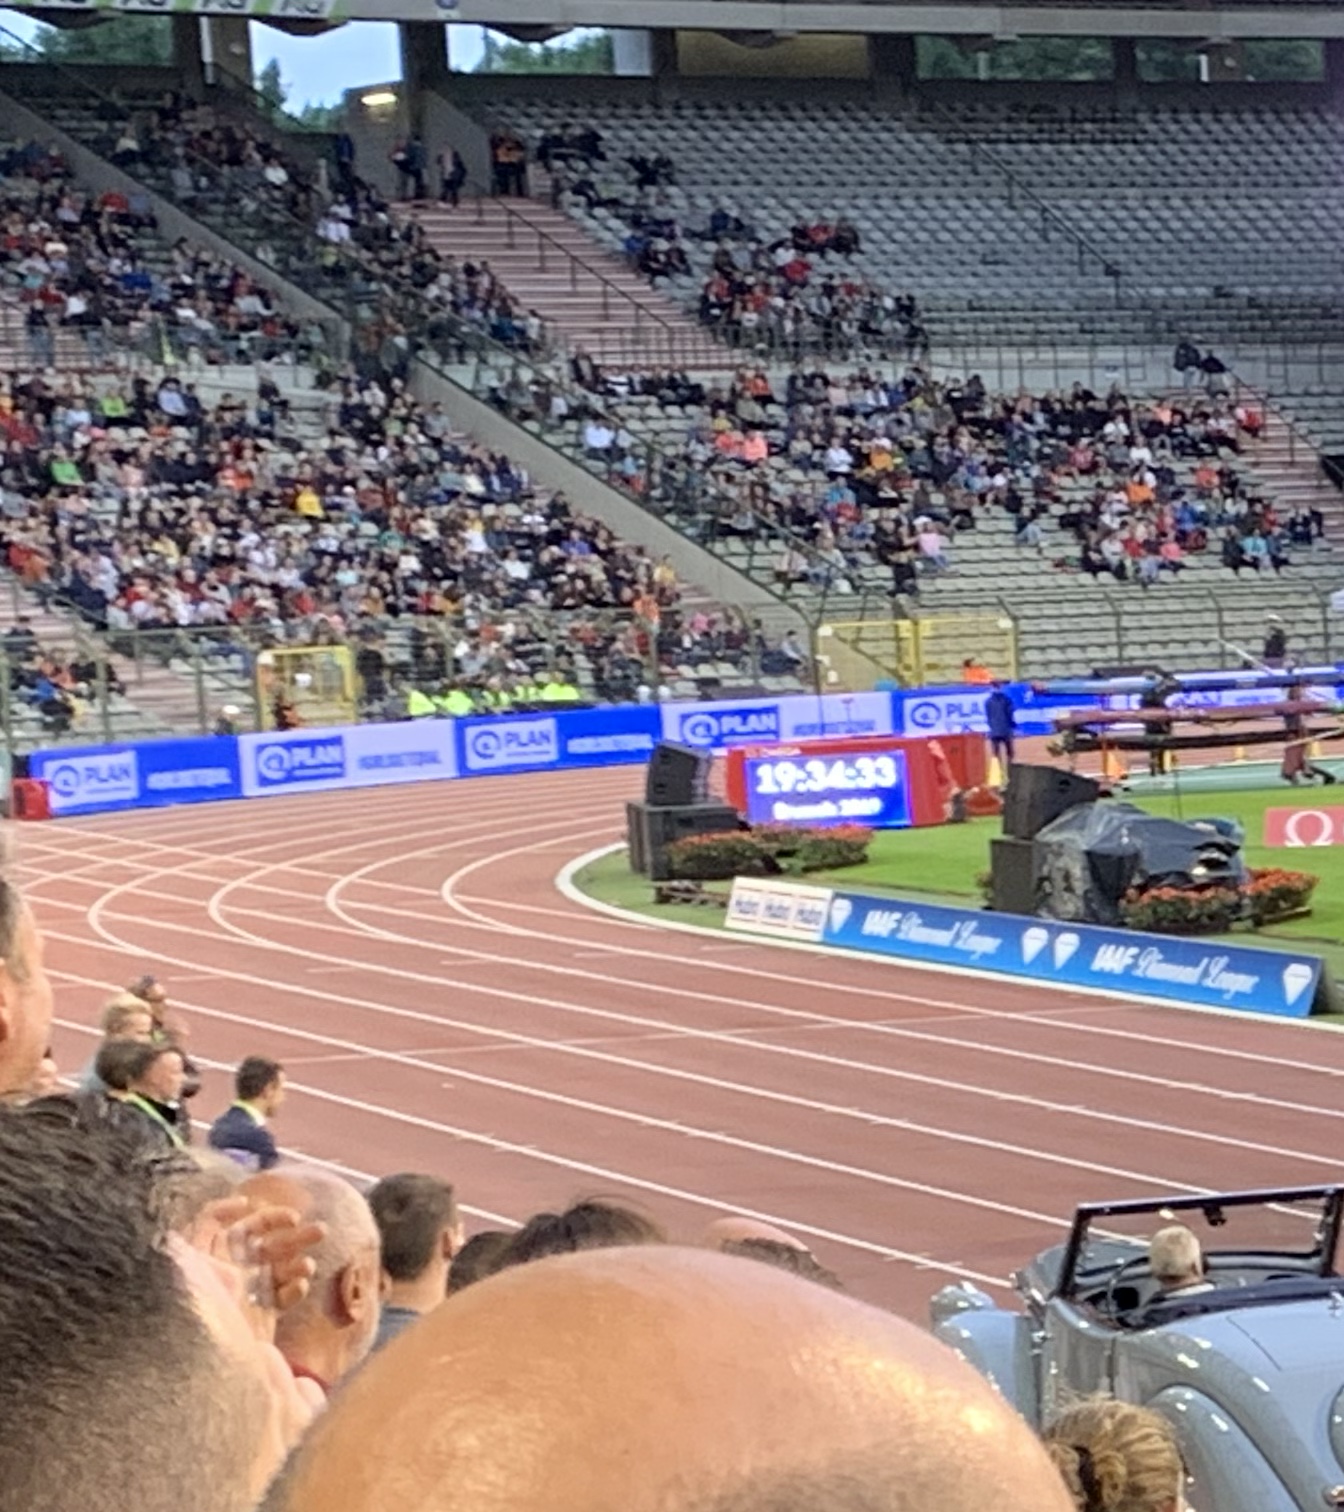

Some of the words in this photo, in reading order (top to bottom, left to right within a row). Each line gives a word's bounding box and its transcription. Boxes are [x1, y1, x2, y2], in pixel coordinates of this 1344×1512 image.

[721, 711, 776, 733] PLAN
[504, 729, 551, 748] PLAN
[292, 743, 344, 765] PLAN
[83, 763, 131, 783] PLAN
[756, 757, 896, 794] 19:34:33
